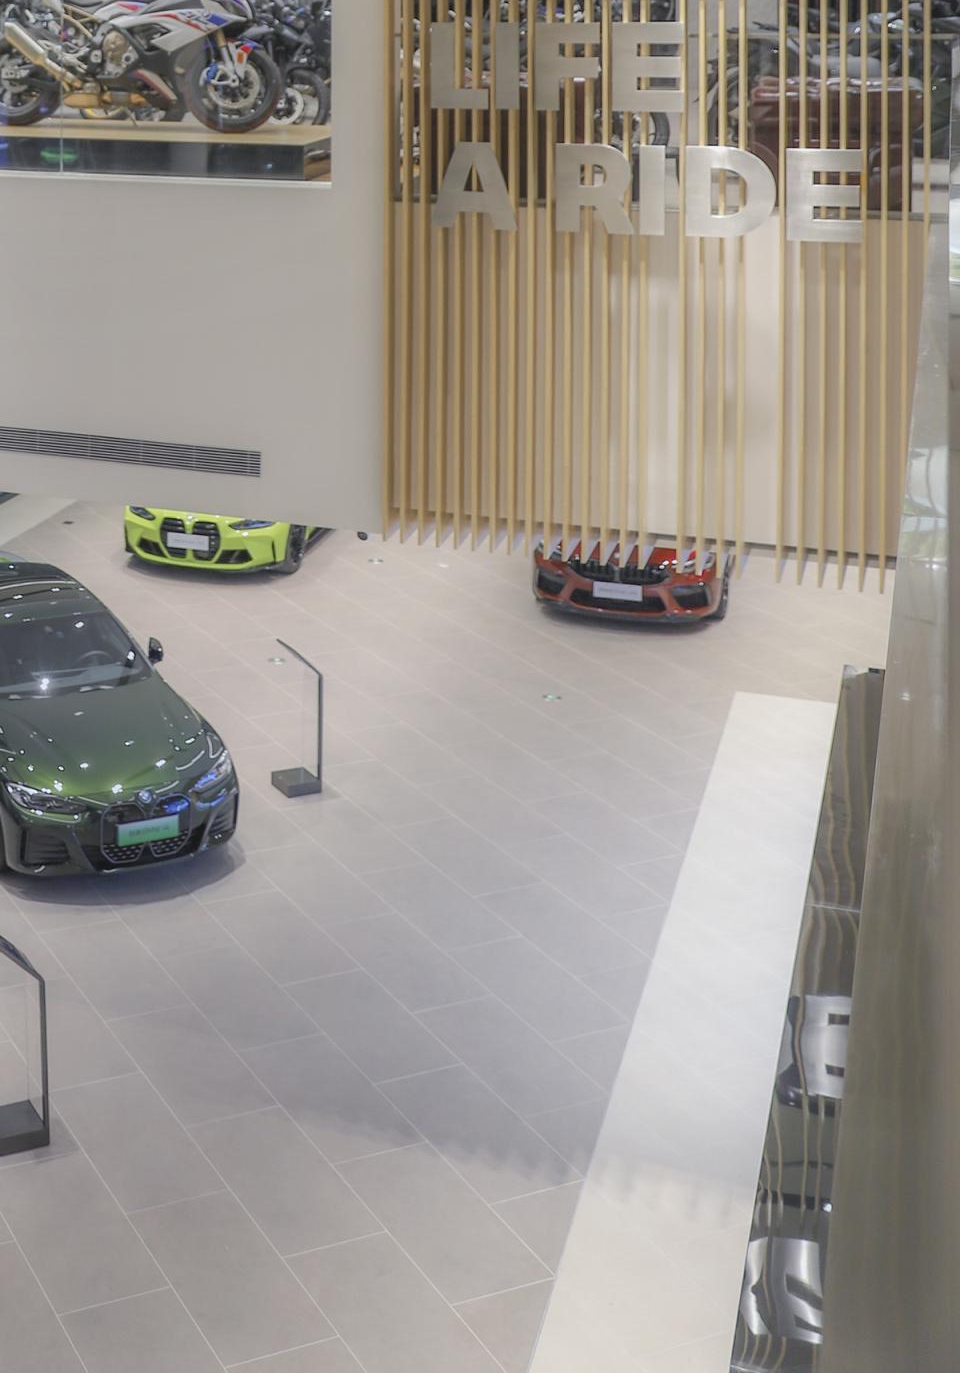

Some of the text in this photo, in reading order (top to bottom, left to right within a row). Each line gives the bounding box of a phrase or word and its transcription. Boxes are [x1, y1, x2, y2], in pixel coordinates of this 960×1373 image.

[430, 21, 686, 113] LIFE
[431, 141, 864, 243] A RIDE
